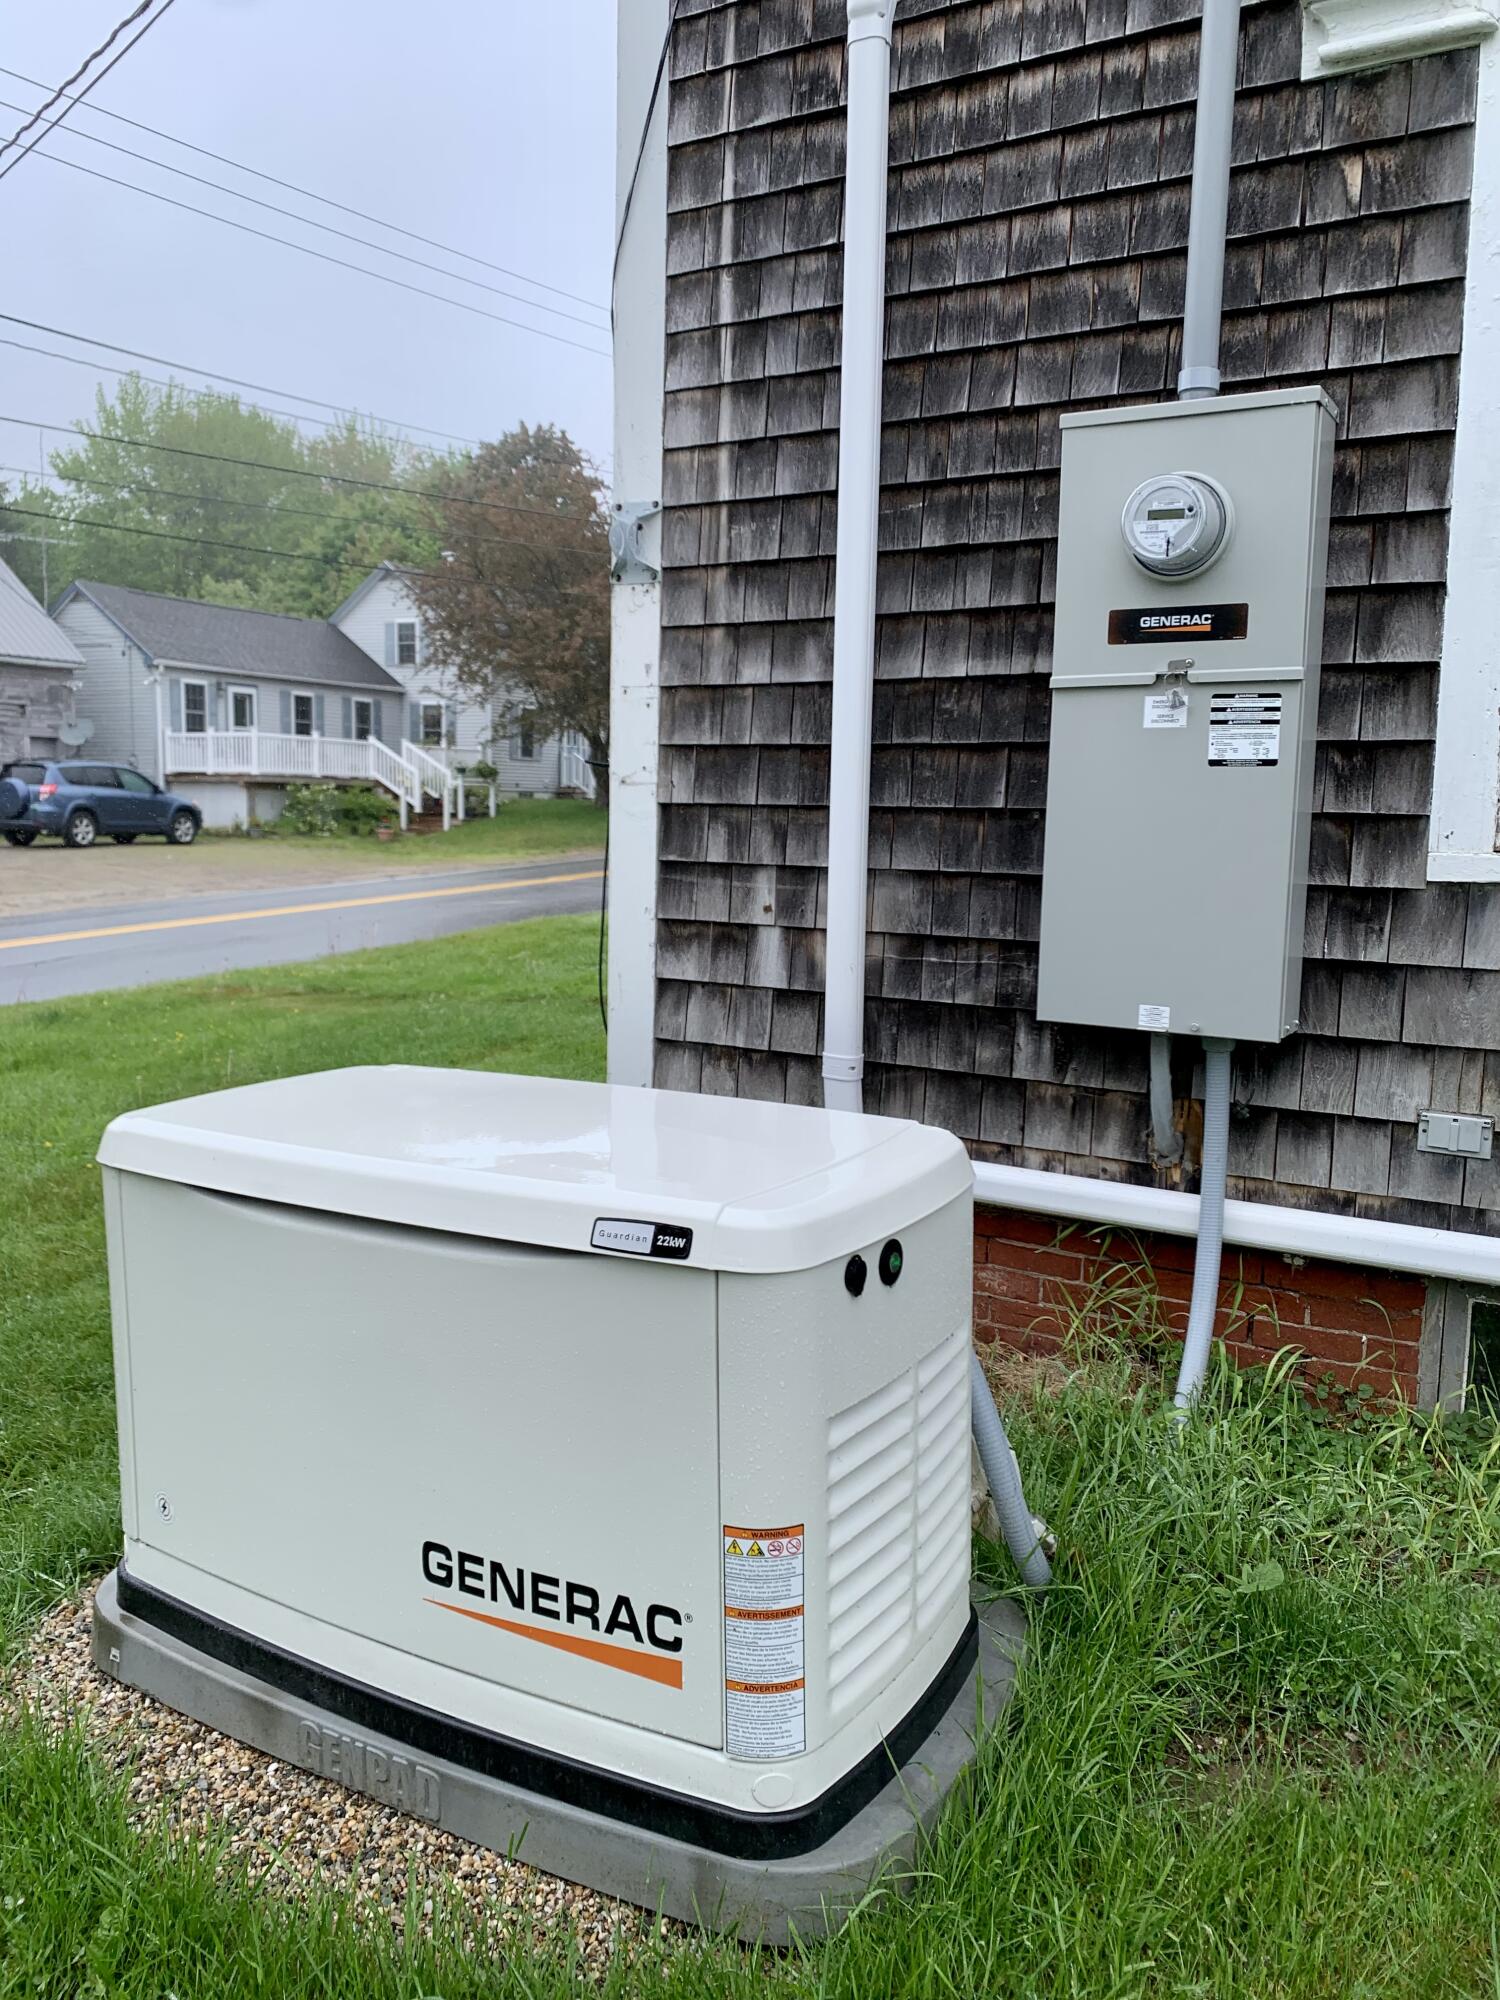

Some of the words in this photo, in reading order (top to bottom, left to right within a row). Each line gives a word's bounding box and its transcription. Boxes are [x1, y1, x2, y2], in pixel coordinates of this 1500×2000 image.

[1140, 614, 1212, 628] GENERAC
[598, 1229, 648, 1243] Guardian
[656, 1235, 687, 1249] 22kW
[751, 1530, 790, 1539] WARNING
[737, 1608, 801, 1620] AVERTISSEMENT
[743, 1682, 799, 1693] ADVERTENCIA
[296, 1719, 442, 1824] GENPAD
